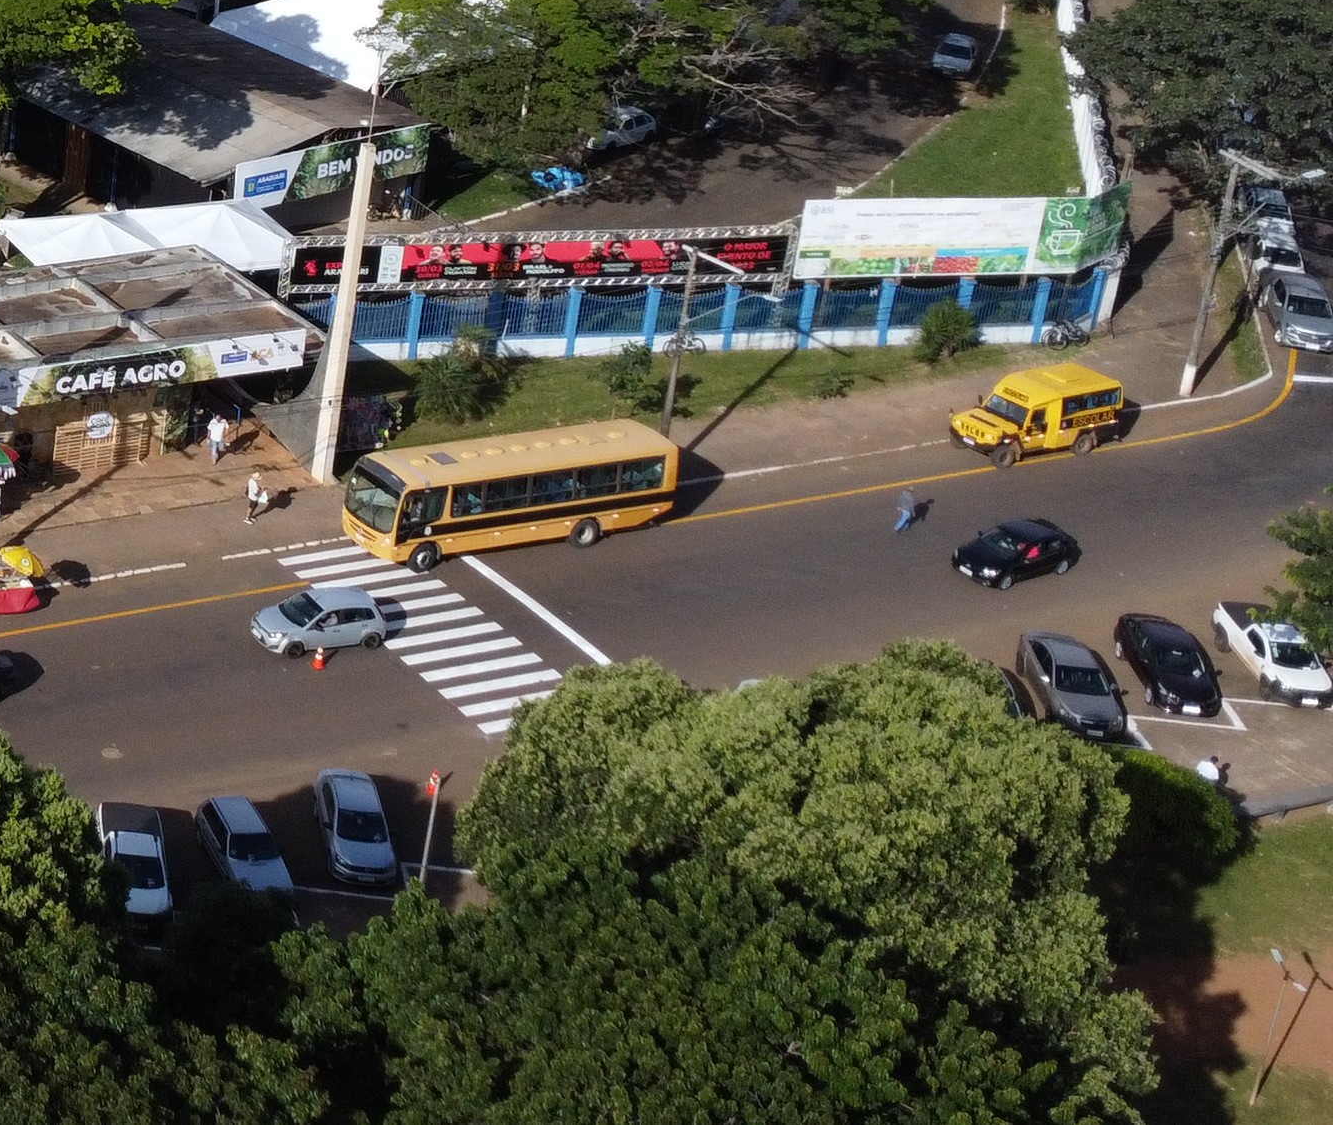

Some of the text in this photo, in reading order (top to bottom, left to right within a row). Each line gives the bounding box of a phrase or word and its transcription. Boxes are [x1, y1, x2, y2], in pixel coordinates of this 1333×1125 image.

[316, 157, 353, 179] BEM
[56, 360, 186, 394] CAFÉ AGRO
[1072, 411, 1115, 427] ESCOLAR
